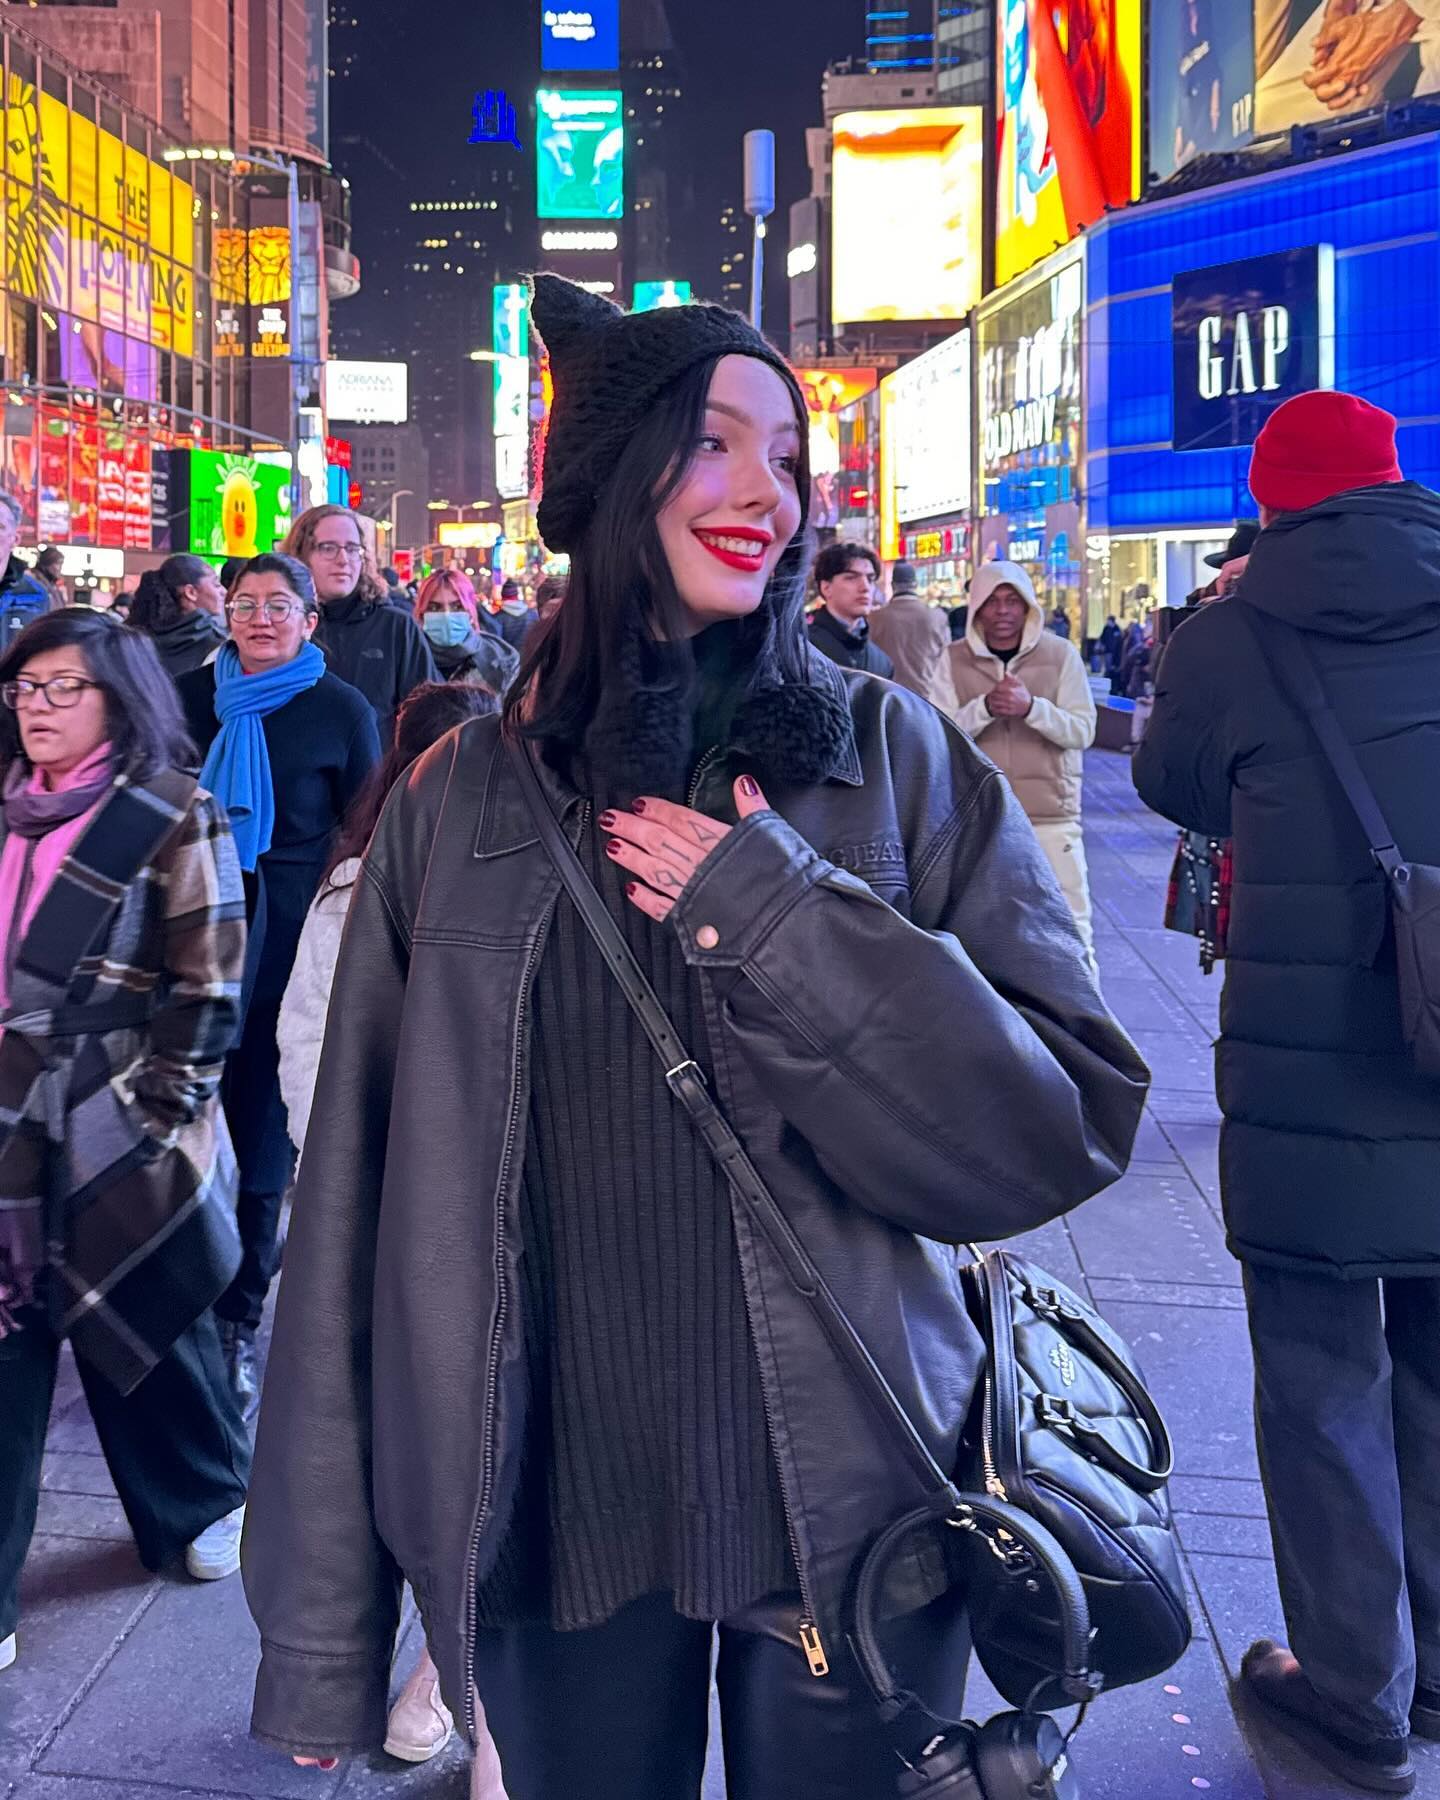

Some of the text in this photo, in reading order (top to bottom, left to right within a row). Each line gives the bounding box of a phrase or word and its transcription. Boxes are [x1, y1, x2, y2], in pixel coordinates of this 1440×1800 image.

[114, 175, 148, 223] THE
[79, 202, 186, 313] LION KING
[1198, 305, 1289, 400] GAP
[984, 393, 1056, 461] OLD NAVY
